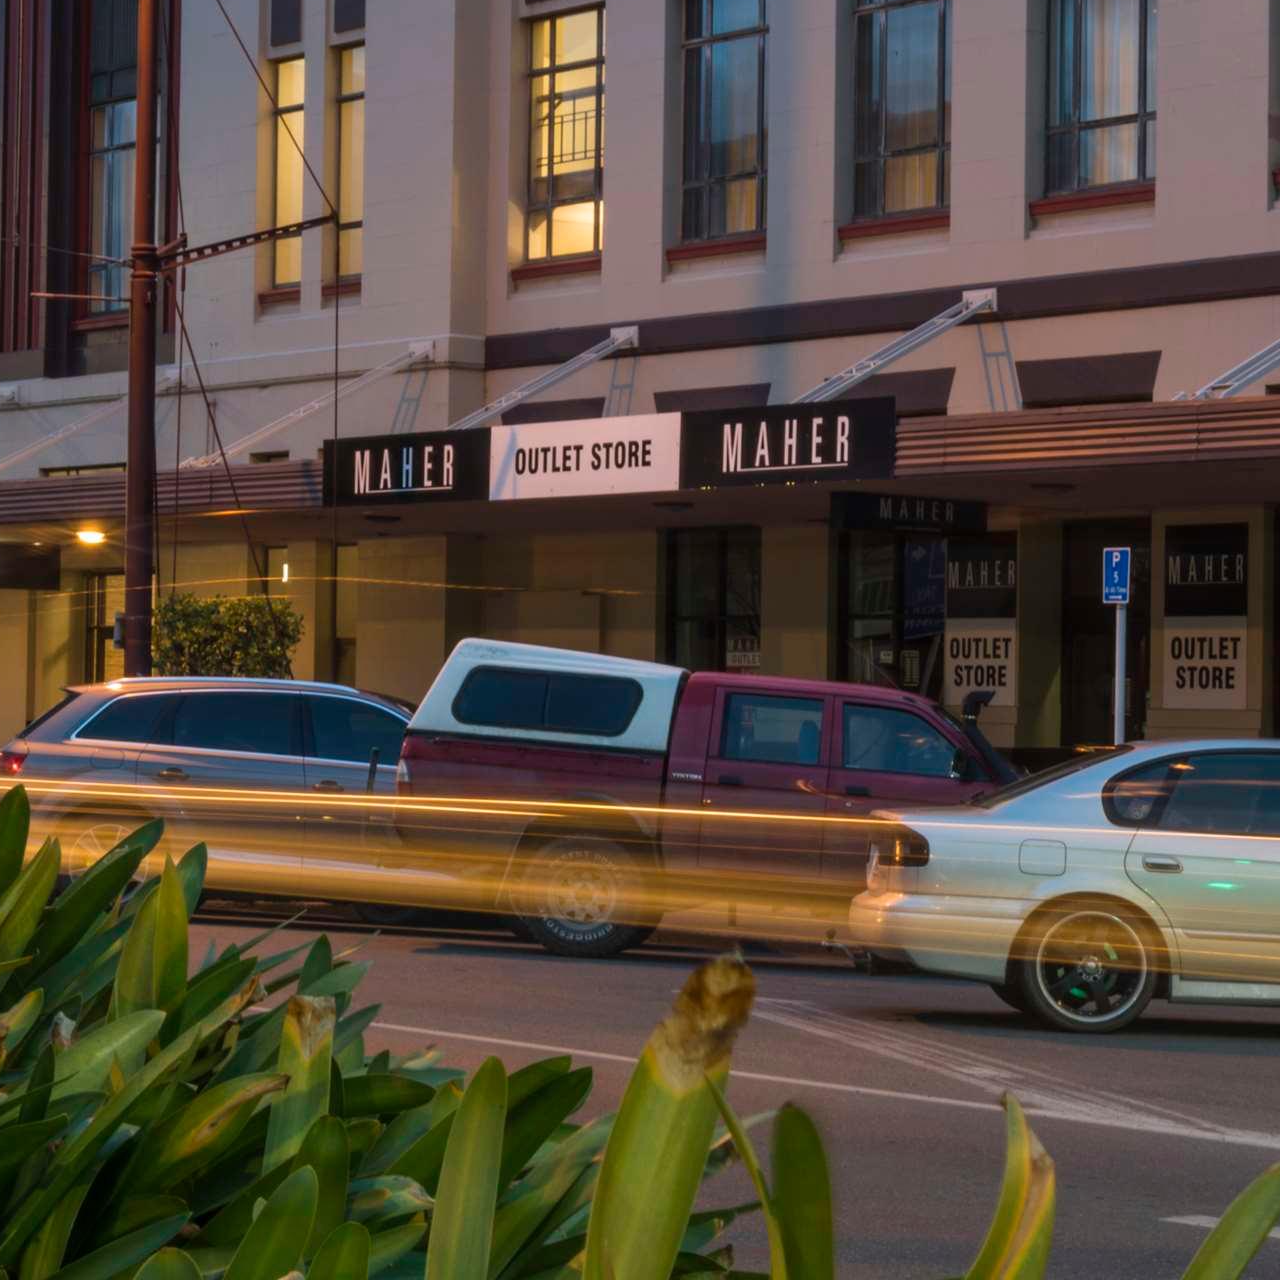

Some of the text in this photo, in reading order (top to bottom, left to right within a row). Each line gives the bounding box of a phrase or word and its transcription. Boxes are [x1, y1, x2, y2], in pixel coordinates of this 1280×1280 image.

[514, 439, 652, 475] OUTLET STORE
[722, 416, 849, 472] MAHER
[354, 444, 454, 495] MAHER
[879, 496, 955, 522] MAHER
[1112, 552, 1121, 568] P
[1168, 553, 1244, 584] MAHER
[948, 560, 1016, 588] MAHER
[950, 637, 1012, 659] OUTLET
[1170, 636, 1241, 661] OUTLET
[954, 665, 1007, 687] STORE
[1175, 666, 1235, 690] STORE
